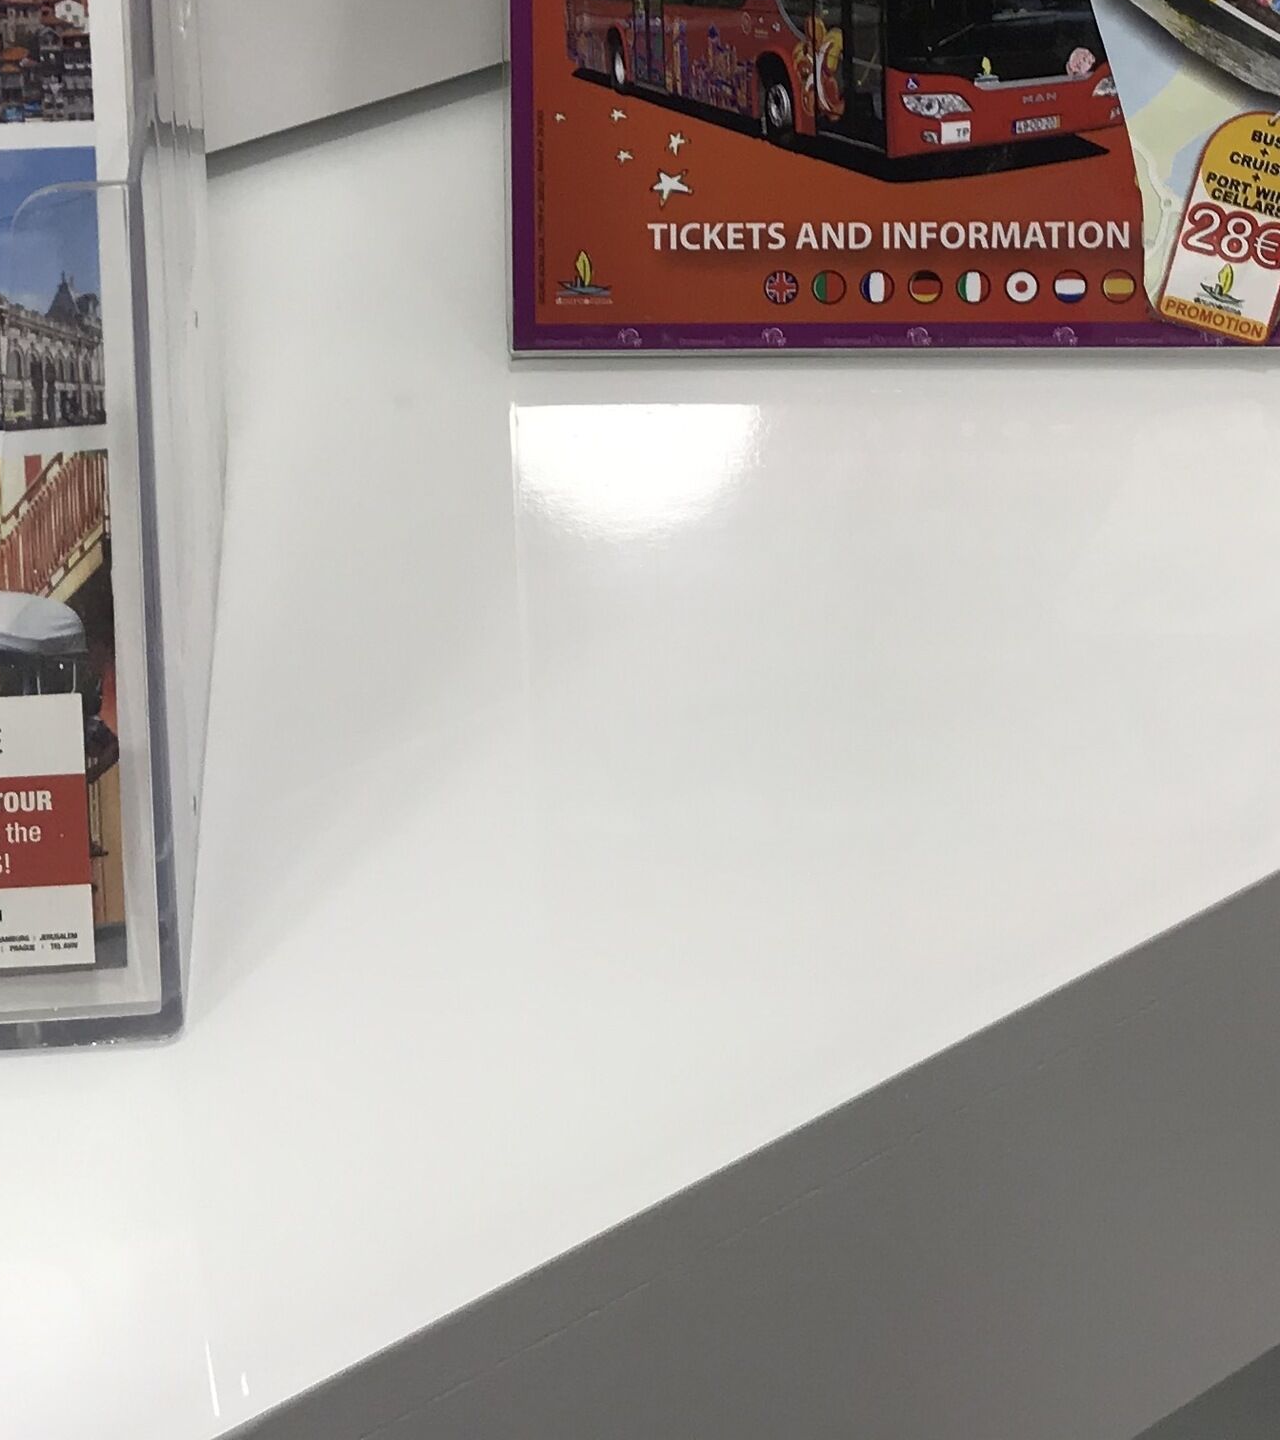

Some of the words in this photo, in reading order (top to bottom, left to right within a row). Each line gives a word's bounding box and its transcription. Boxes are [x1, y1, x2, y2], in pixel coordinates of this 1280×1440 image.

[1023, 93, 1057, 105] MAN
[1206, 171, 1252, 195] PORT
[647, 222, 785, 250] TICKETS
[795, 221, 873, 249] AND
[883, 220, 1131, 249] INFORMATION
[1164, 299, 1264, 338] PROMOTION
[6, 821, 41, 843] the
